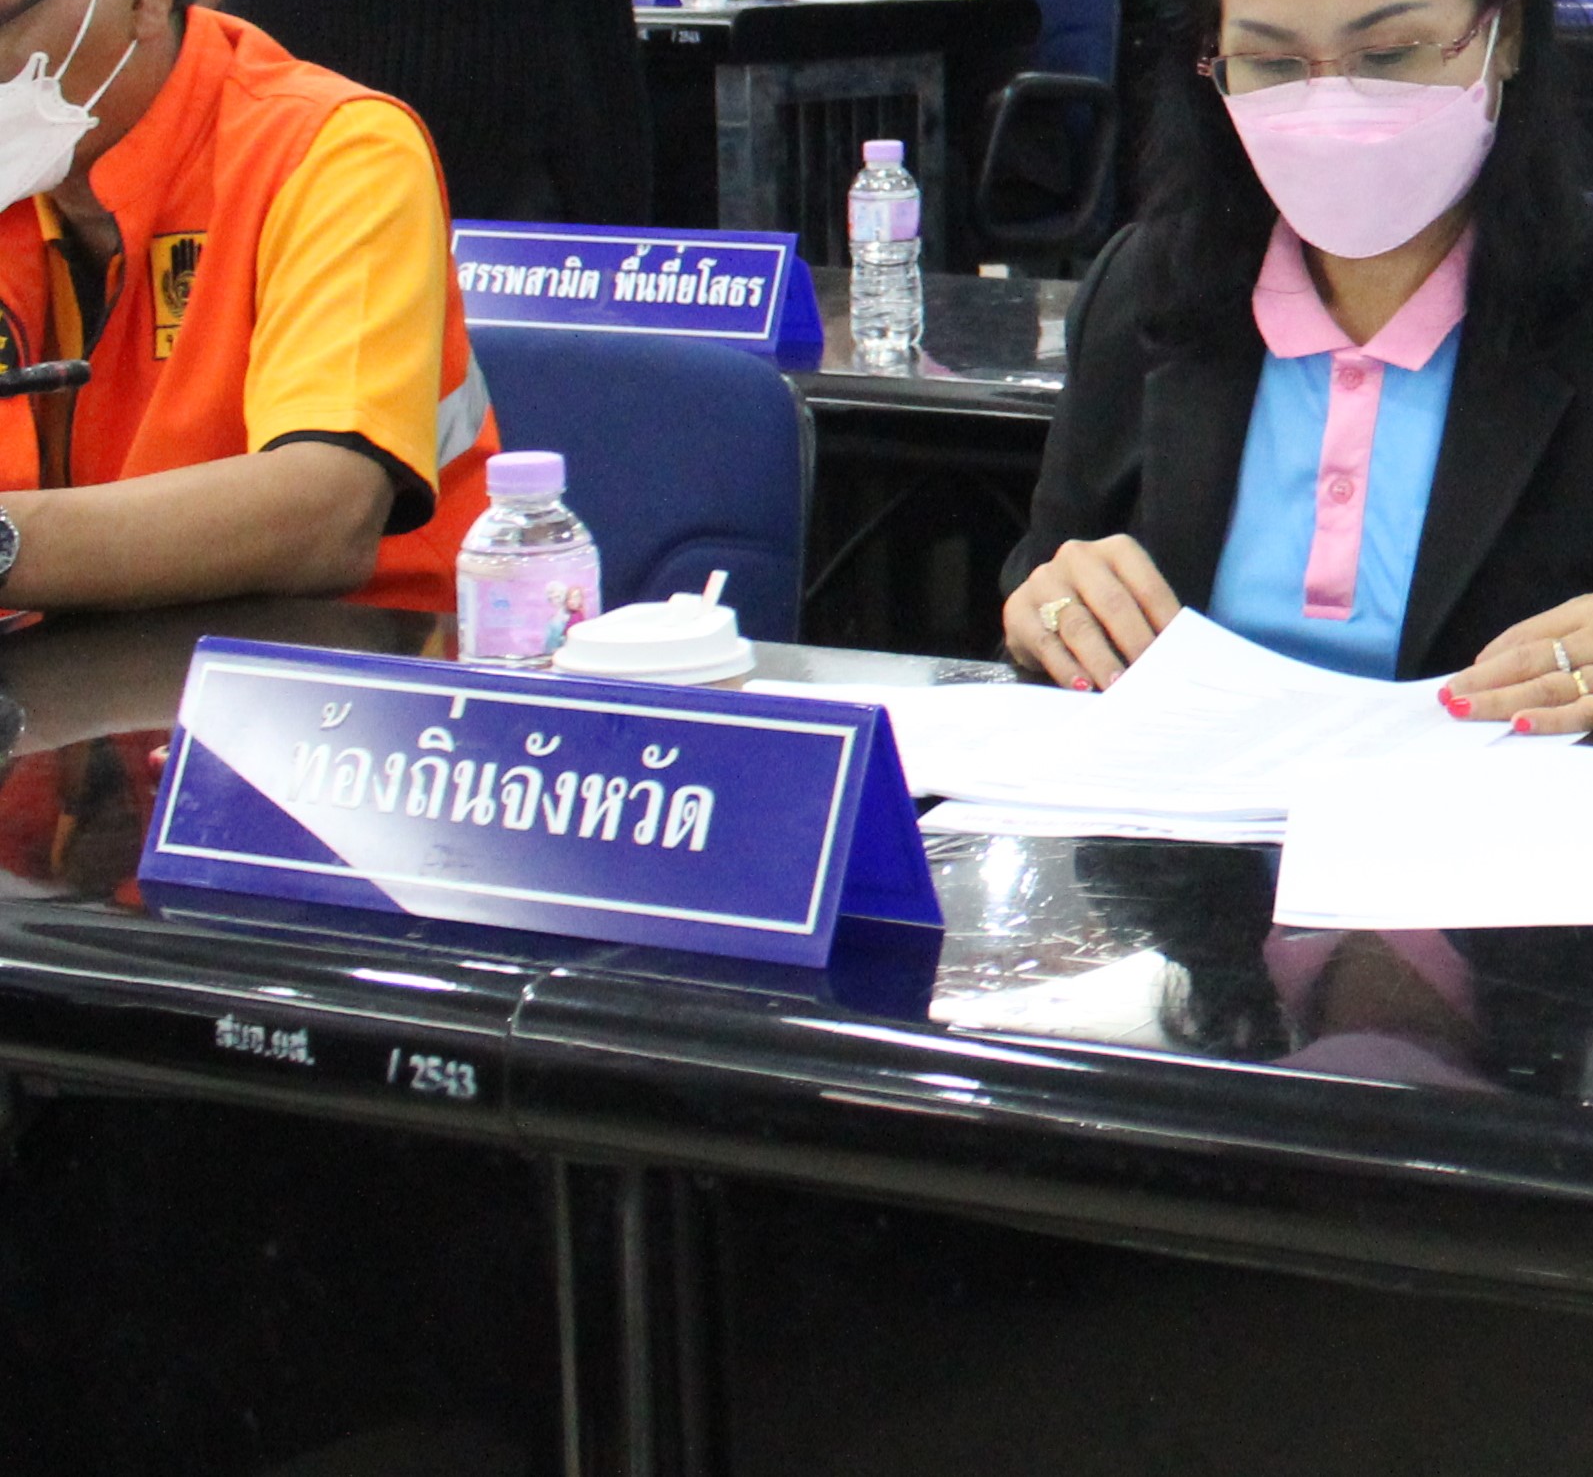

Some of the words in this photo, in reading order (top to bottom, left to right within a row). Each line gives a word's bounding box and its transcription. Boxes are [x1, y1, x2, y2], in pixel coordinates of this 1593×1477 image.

[457, 256, 601, 300] สรรพสามิต
[613, 244, 766, 308] พื้นที่ยโสธร
[287, 695, 715, 852] ท้องถิ่นจังหวัด
[409, 1053, 478, 1100] 2543
